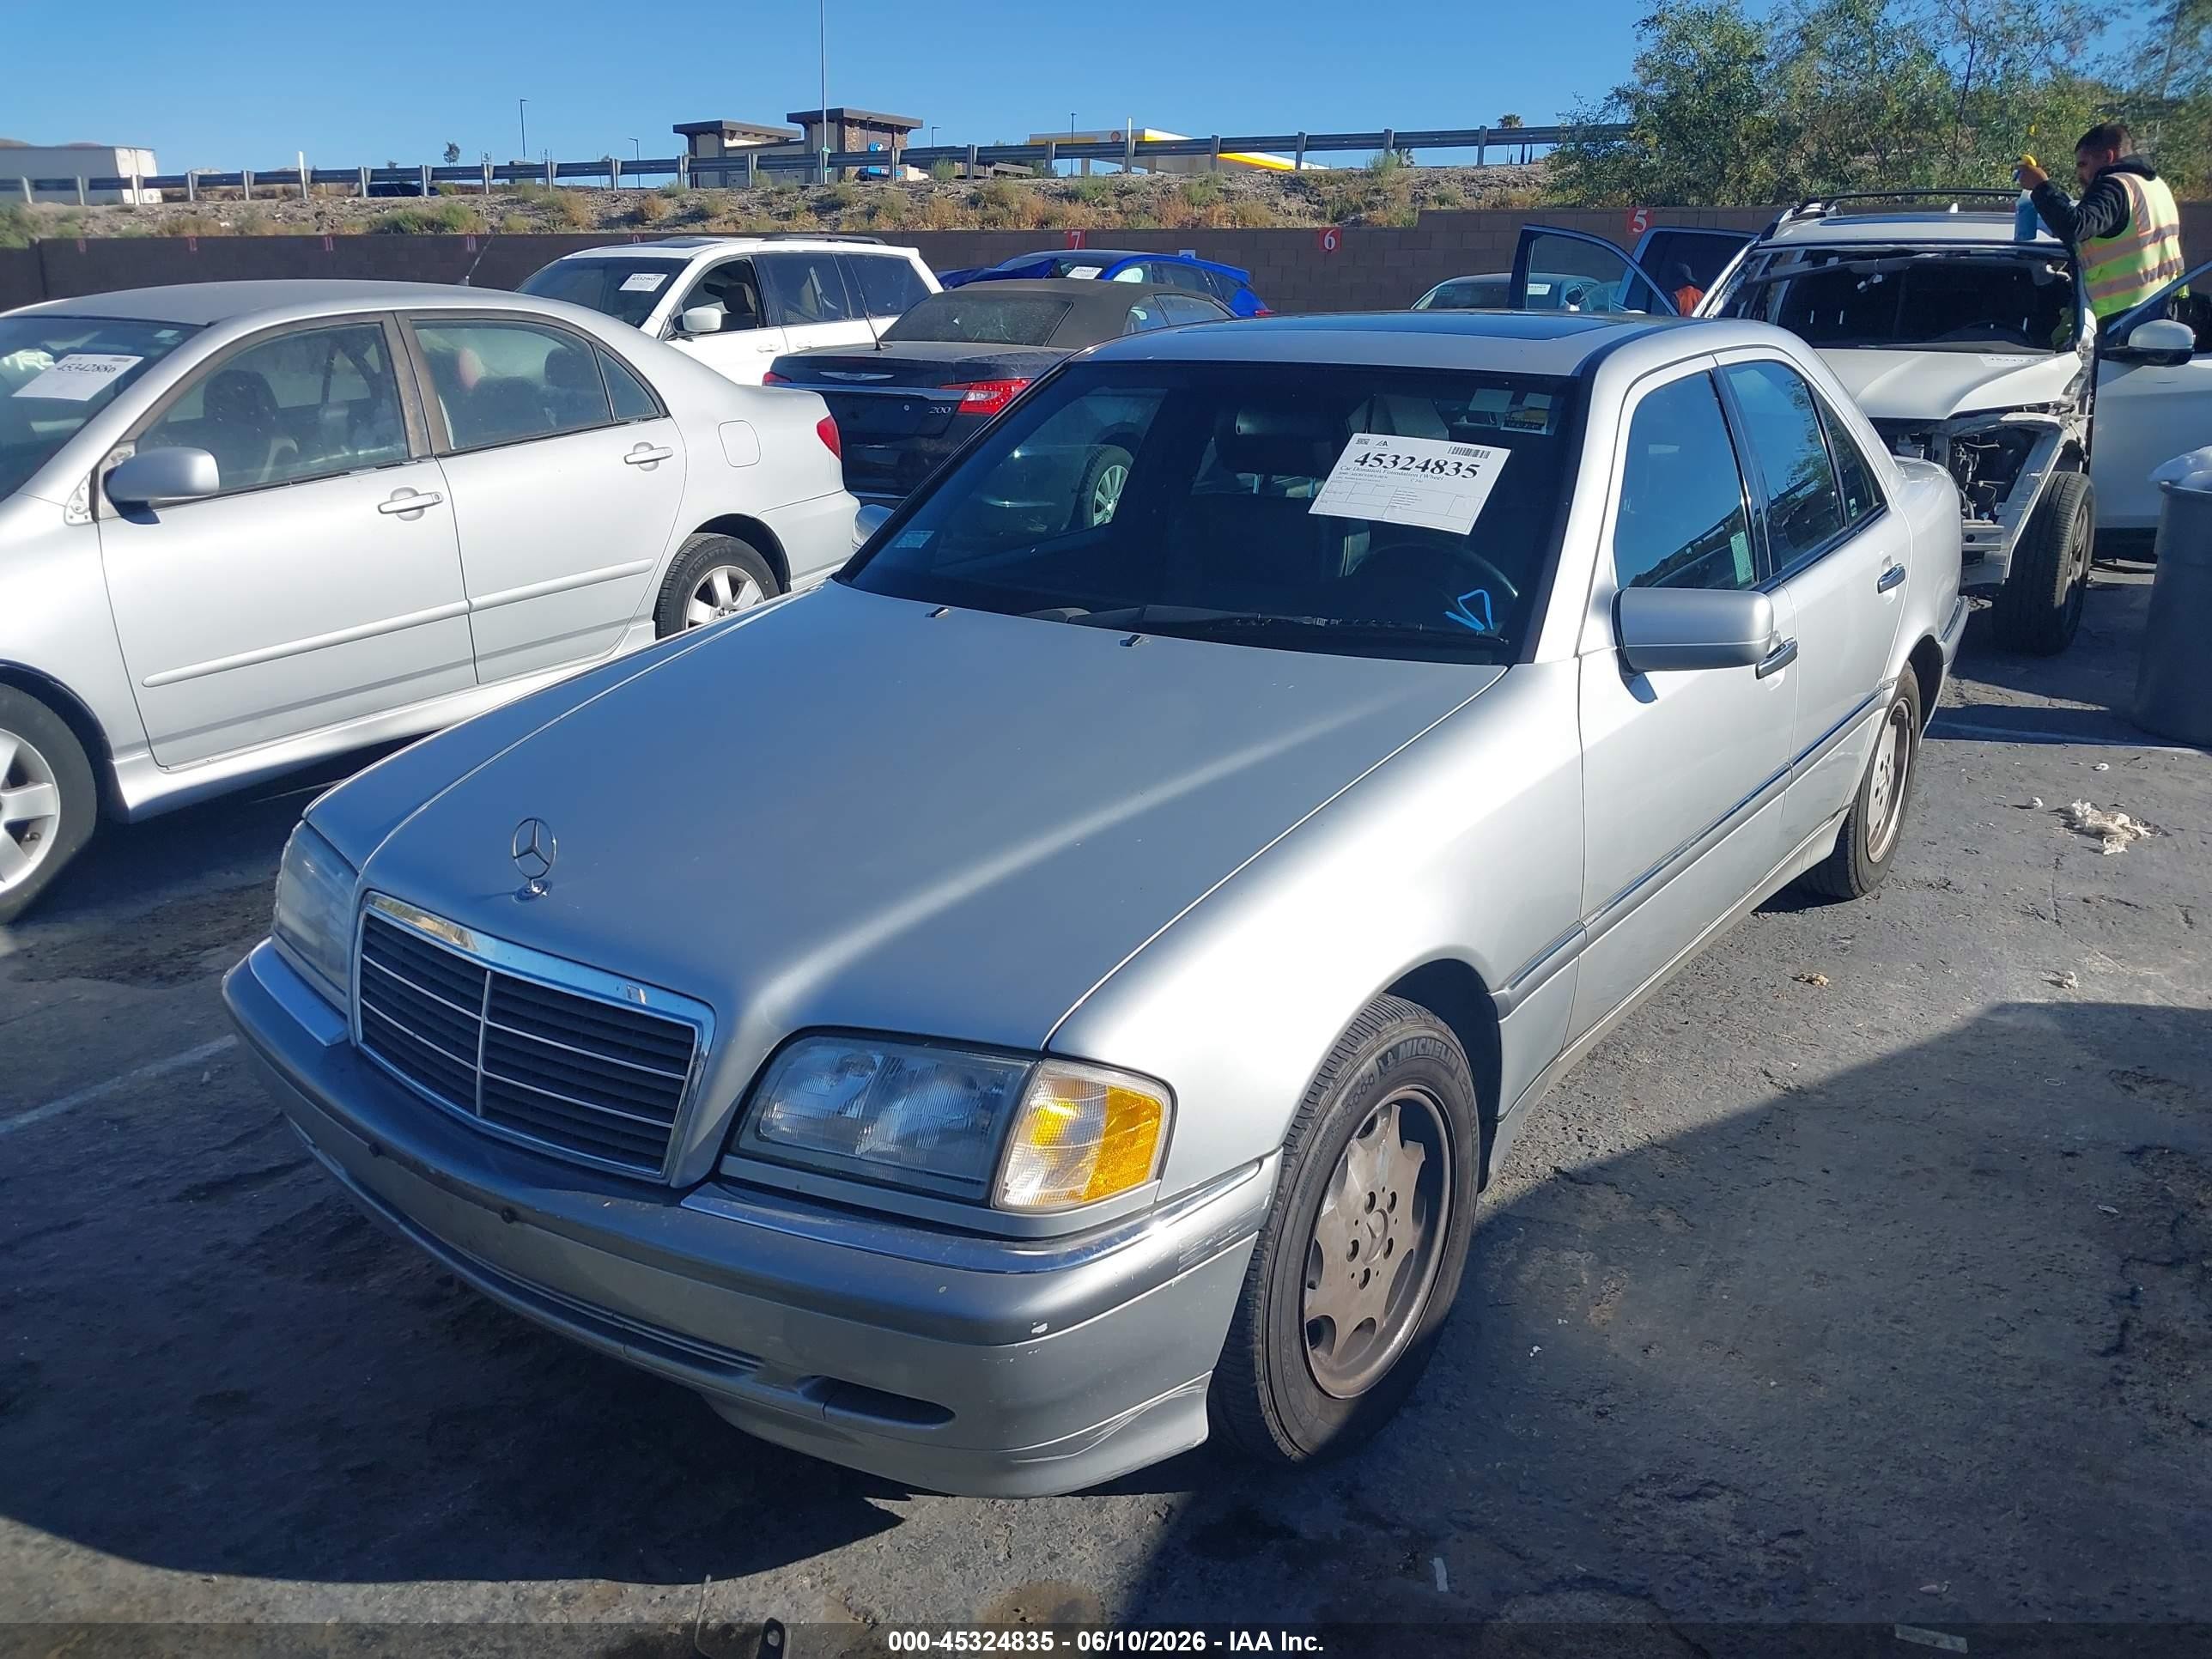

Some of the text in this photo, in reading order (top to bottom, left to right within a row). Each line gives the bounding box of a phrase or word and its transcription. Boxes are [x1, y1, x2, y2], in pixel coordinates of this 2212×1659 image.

[1633, 210, 1648, 233] 5
[1071, 231, 1081, 250] 7
[1324, 229, 1336, 250] 6
[1354, 452, 1480, 479] 45324835
[1399, 1037, 1461, 1072] MICHELIN
